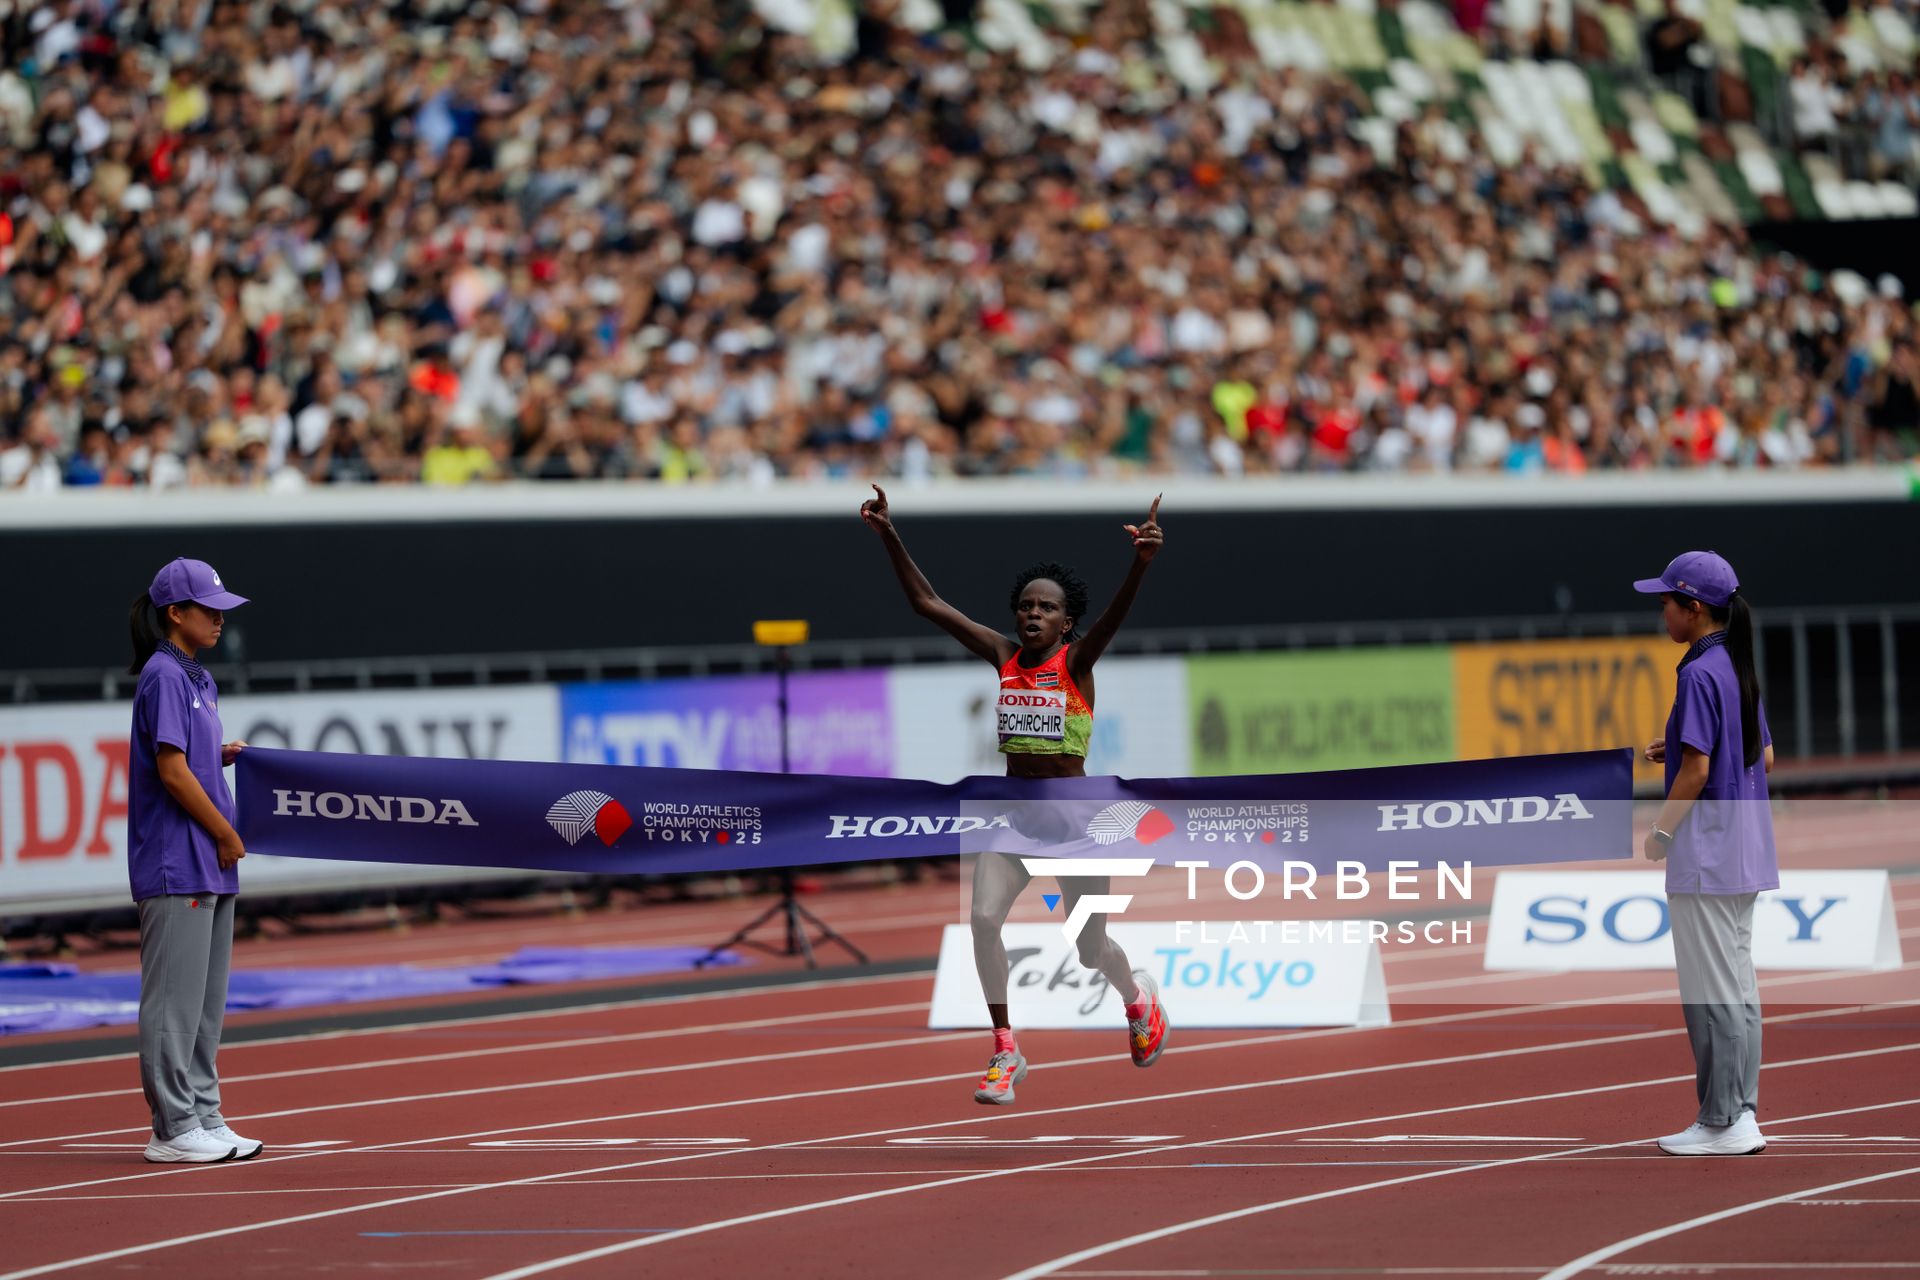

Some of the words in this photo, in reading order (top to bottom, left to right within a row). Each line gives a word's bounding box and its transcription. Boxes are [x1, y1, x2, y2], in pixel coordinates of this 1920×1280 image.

[1489, 655, 1660, 764] SEIKO
[0, 737, 131, 862] DA
[272, 789, 479, 826] HONDA
[644, 803, 689, 815] WORLD
[692, 805, 761, 817] ATHLETICS
[1187, 806, 1235, 819] WORLD
[1238, 804, 1308, 817] ATHLETICS
[1377, 793, 1594, 832] HONDA
[643, 816, 762, 830] CHAMPIONSHIPS
[825, 815, 1010, 839] HONDA
[1187, 816, 1309, 831] CHAMPIONSHIPS
[1524, 896, 1848, 944] SOY
[1152, 948, 1315, 1001] Tokyo
